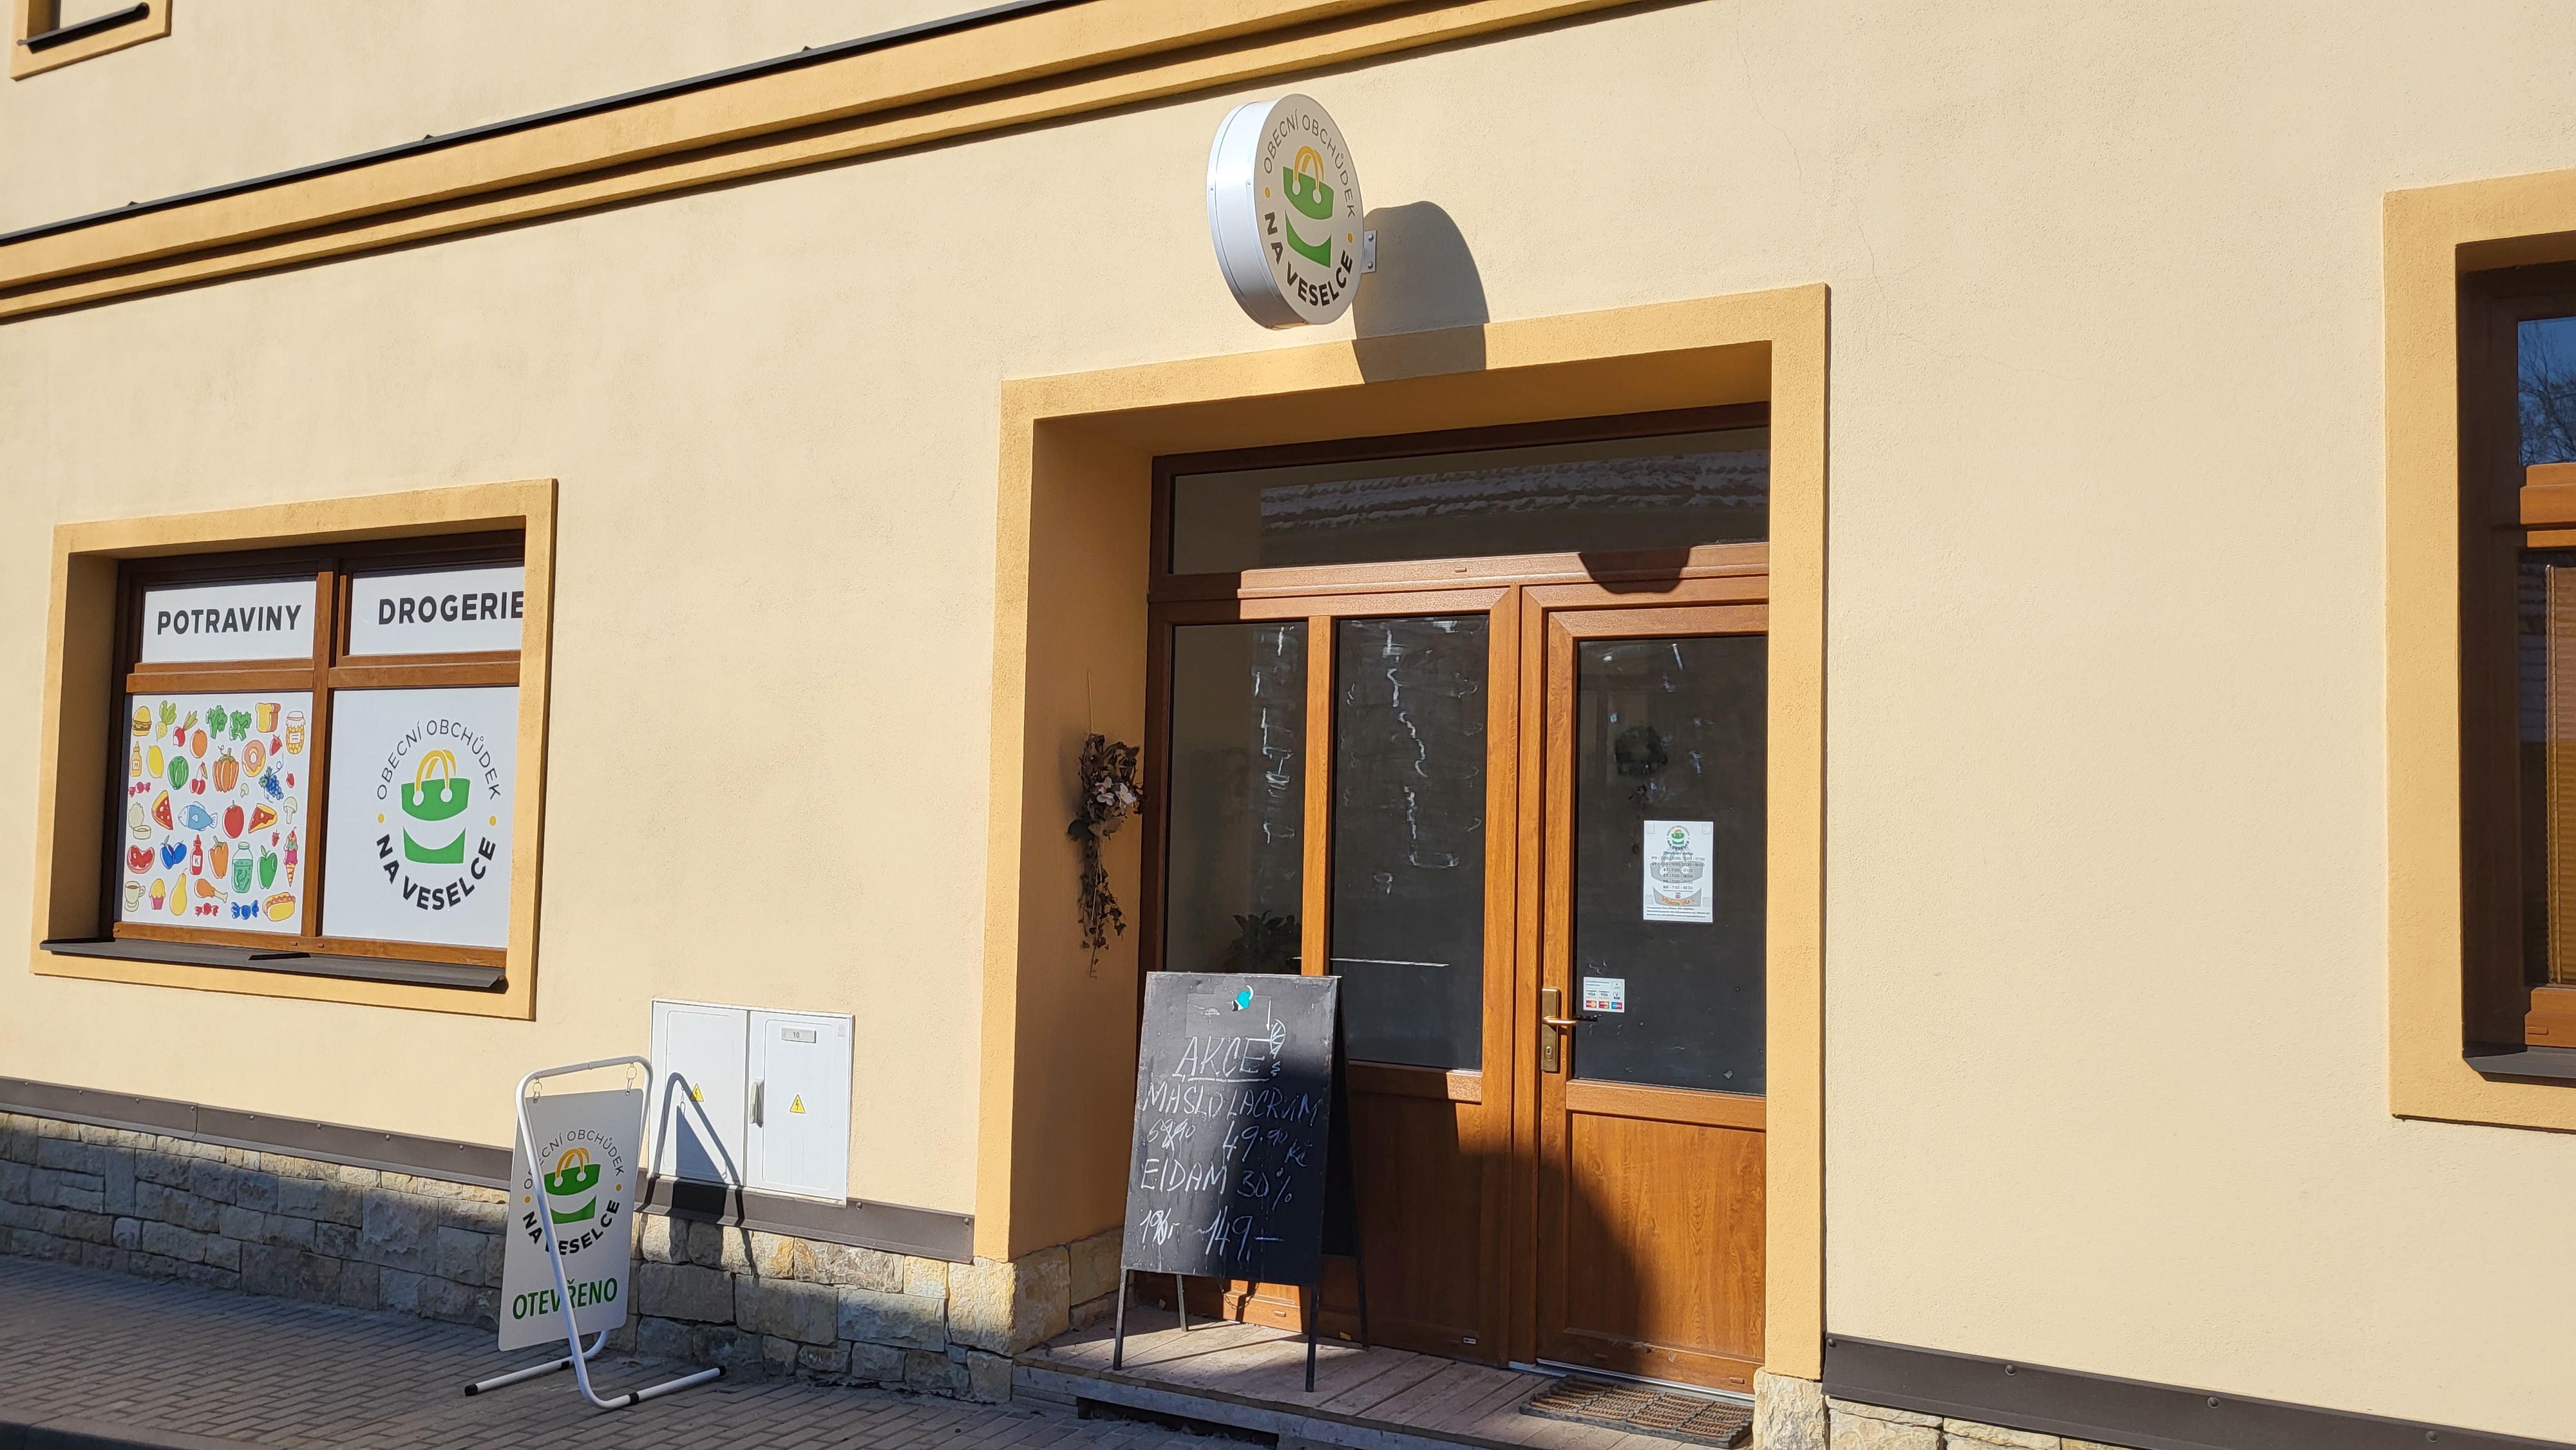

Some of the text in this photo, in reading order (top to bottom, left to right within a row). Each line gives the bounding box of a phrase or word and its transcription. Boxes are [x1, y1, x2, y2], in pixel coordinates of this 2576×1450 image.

[1264, 109, 1356, 218] OBECNÍ OBCHŮDEK
[1264, 212, 1353, 307] NA VESELCE
[156, 605, 302, 636] POTRAVINY
[378, 590, 524, 625] DROGERIE
[377, 719, 501, 800] OBECNÍ OBCHŮDEK
[376, 834, 497, 910] NA VESELCE
[1173, 1035, 1271, 1078] AKCE
[524, 1129, 625, 1190] OCNÍ OBCHŮDEK
[1141, 1157, 1227, 1194] EIDAM
[522, 1210, 543, 1245] NA
[512, 1277, 618, 1320] OTEVŘENO
